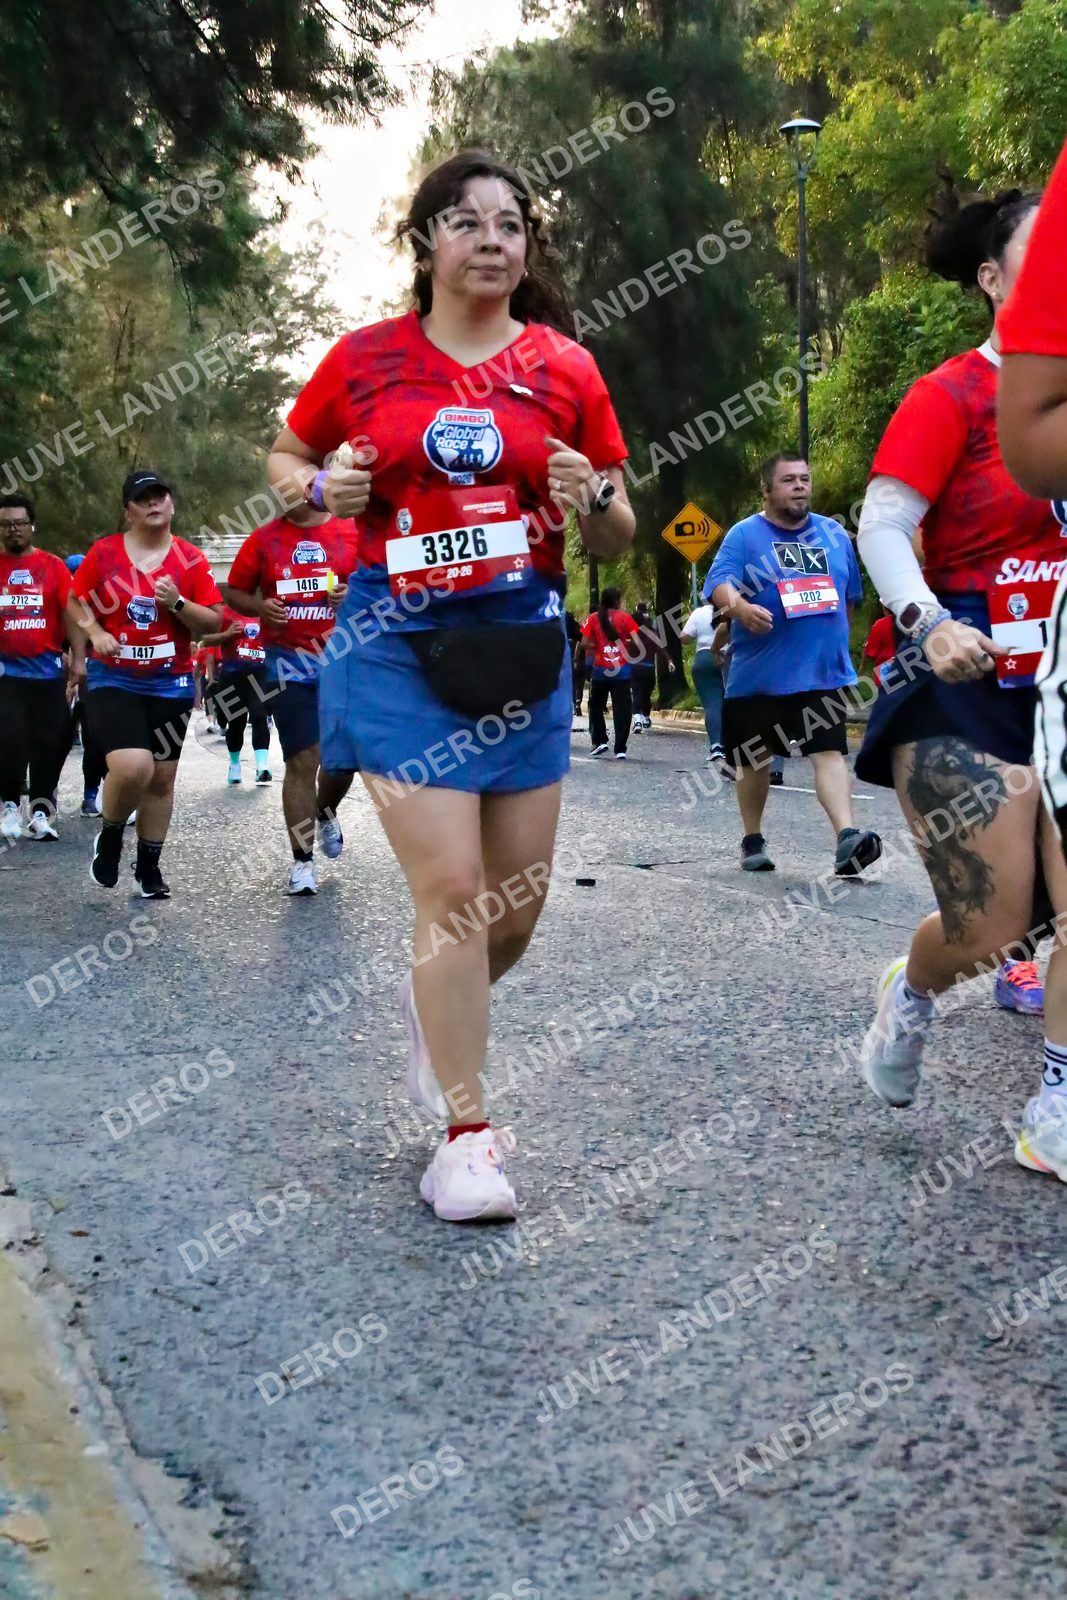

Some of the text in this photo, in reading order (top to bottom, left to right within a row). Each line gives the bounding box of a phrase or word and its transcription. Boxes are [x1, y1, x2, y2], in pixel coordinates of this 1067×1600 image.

[445, 414, 486, 423] BIMBO
[443, 426, 485, 440] Global
[435, 437, 468, 449] Race
[421, 527, 488, 565] 3326
[447, 565, 473, 579] 20-26
[296, 578, 319, 592] 1416
[11, 596, 29, 605] 2712
[799, 590, 822, 603] 1202
[284, 606, 336, 620] SANTIAG
[4, 618, 47, 630] SANTIAGO
[131, 647, 155, 658] 1417
